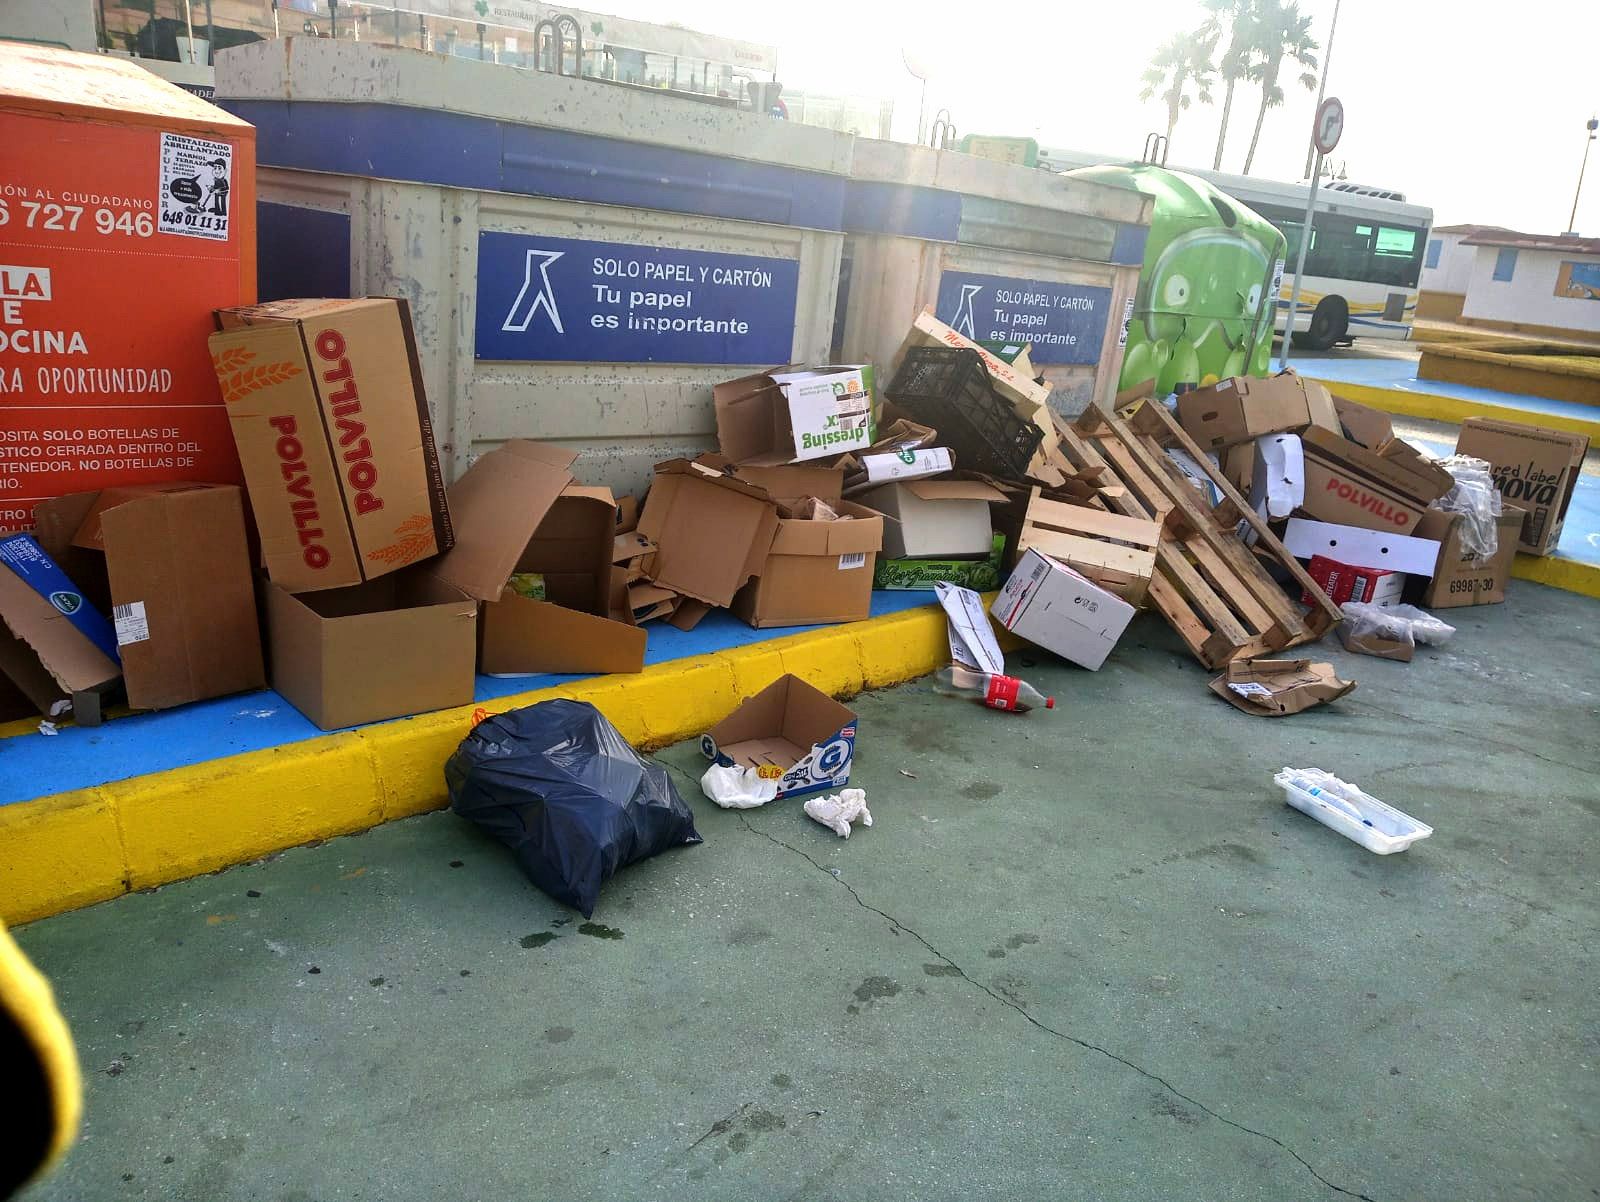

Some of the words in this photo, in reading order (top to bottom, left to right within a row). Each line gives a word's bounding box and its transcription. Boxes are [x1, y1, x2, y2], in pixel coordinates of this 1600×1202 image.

[163, 141, 231, 157] ABRILLANTADO
[166, 135, 229, 151] CRISTALIZADO
[35, 189, 55, 200] AL
[62, 191, 153, 210] CIUDADANO
[21, 201, 84, 231] 727
[95, 208, 154, 237] 946
[163, 209, 184, 224] 648
[185, 214, 198, 226] 01
[200, 216, 213, 228] 11
[213, 218, 228, 231] 31
[2, 271, 45, 296] LA
[593, 258, 640, 278] SOLO
[645, 262, 694, 283] PAPEL
[700, 267, 709, 284] Y
[713, 268, 772, 288] CARTÓN
[592, 284, 621, 304] Tu
[629, 291, 692, 309] papel
[996, 289, 1021, 305] SOLO
[1023, 293, 1051, 308] PAPEL
[1053, 295, 1060, 307] Y
[1060, 296, 1094, 311] CARTÓN
[4, 300, 23, 324] E
[994, 309, 1009, 323] Tu
[1013, 313, 1048, 328] papel
[591, 314, 620, 328] es
[629, 312, 749, 335] importante
[990, 331, 1006, 342] es
[1010, 330, 1077, 345] importante
[37, 367, 172, 394] OPORTUNIDAD
[315, 328, 384, 516] POLVILLO
[43, 430, 84, 441] SOLO
[88, 428, 158, 440] BOTELLAS
[162, 428, 180, 438] DE
[802, 428, 864, 449] dressing
[46, 445, 114, 457] CERRADA
[118, 443, 173, 455] DENTRO
[177, 442, 201, 453] DEL
[79, 459, 100, 471] NO
[105, 458, 173, 470] BOTELLAS
[177, 457, 194, 468] DE
[431, 460, 438, 470] de
[1494, 464, 1520, 478] red
[1525, 461, 1566, 486] label
[268, 415, 331, 569] POLVILLO
[1326, 478, 1409, 526] POLVILLO
